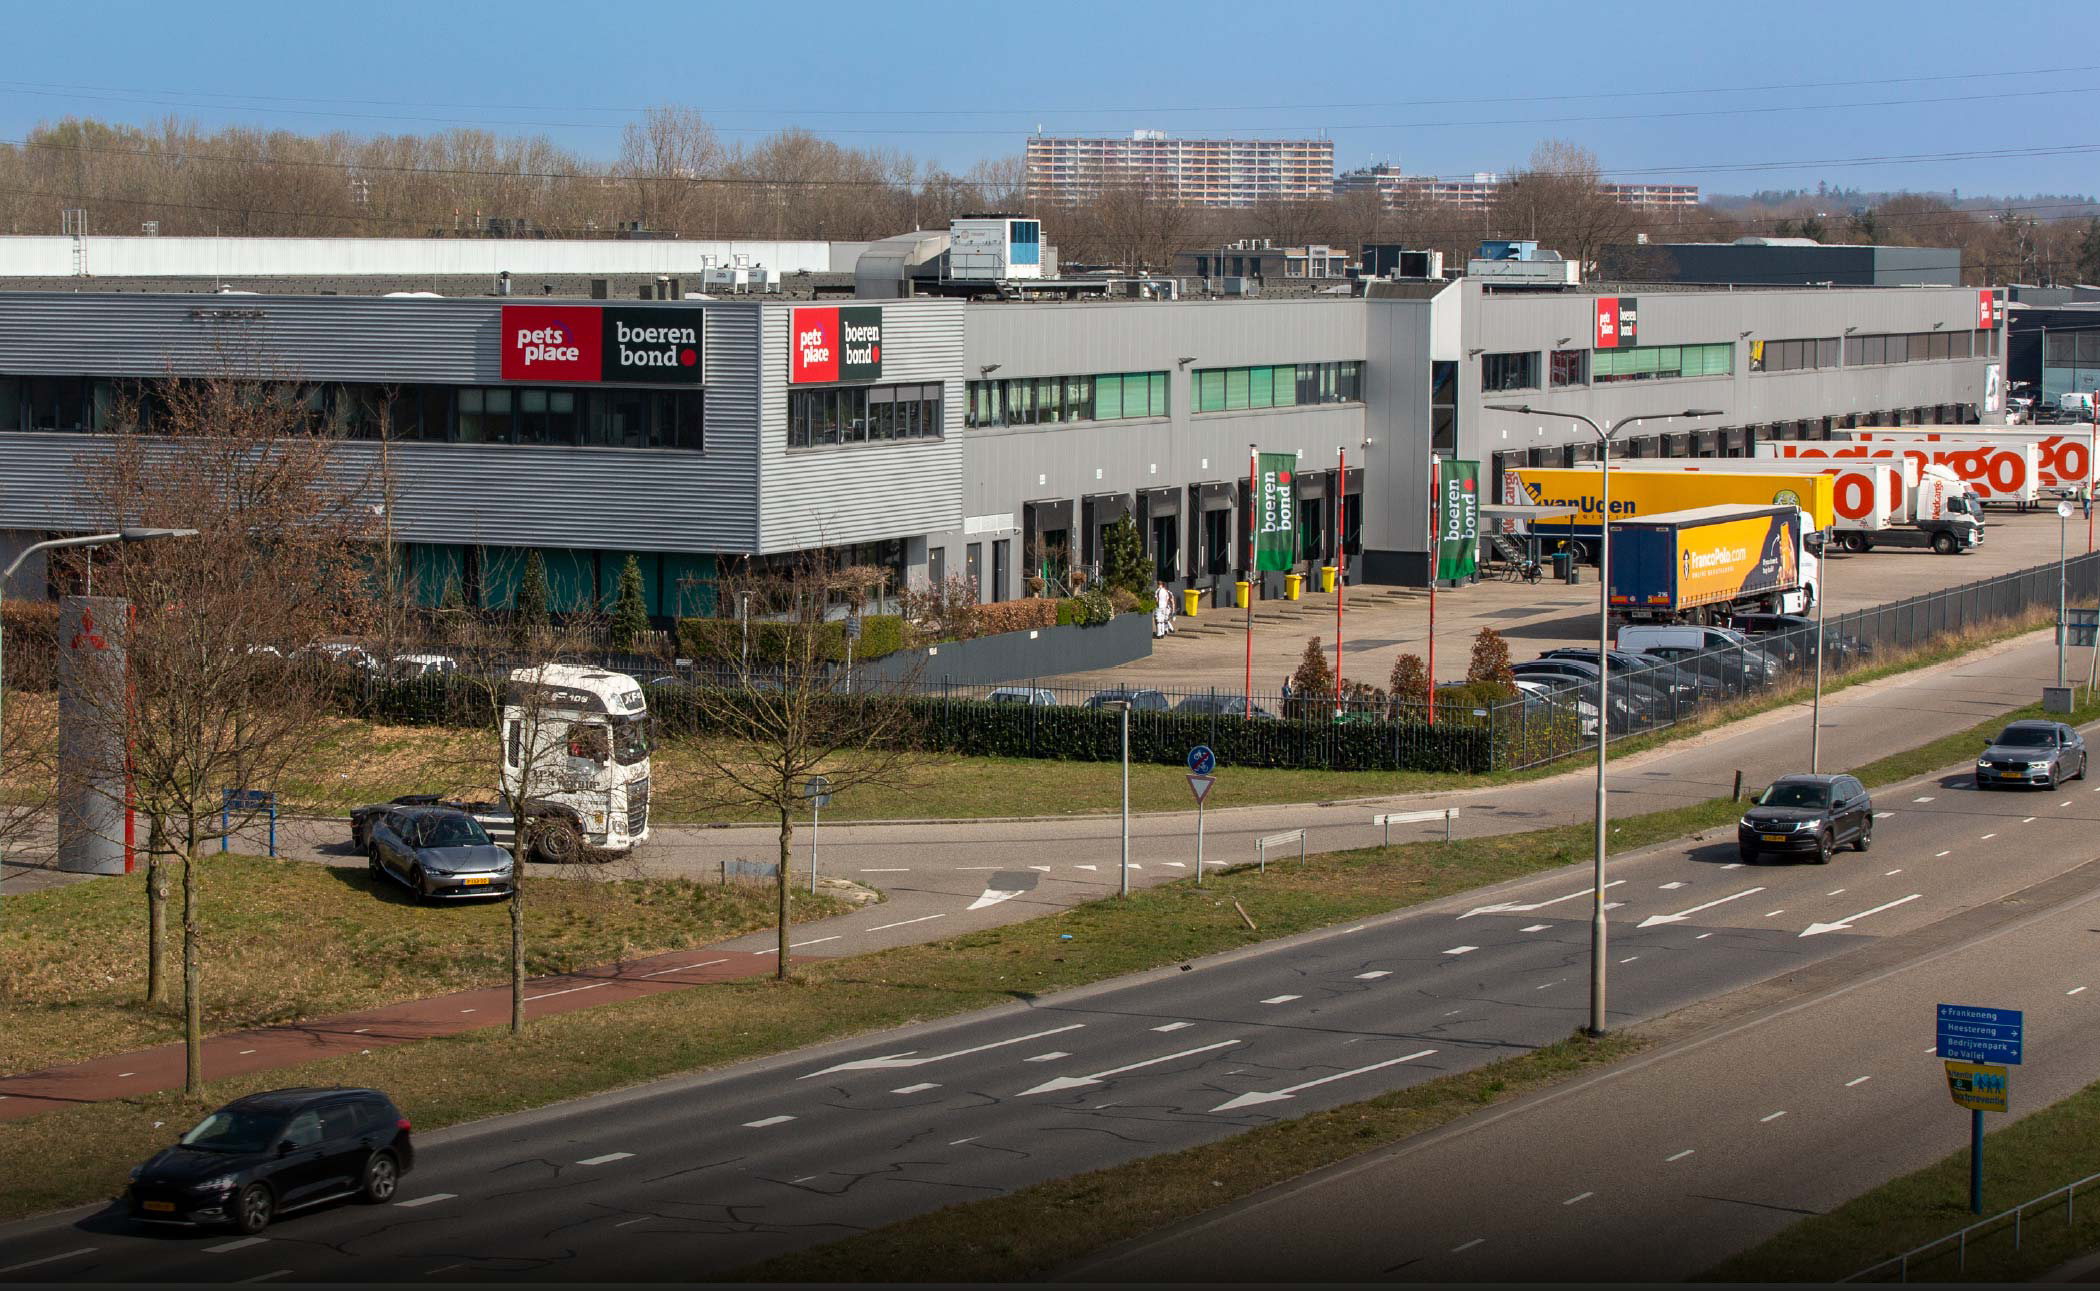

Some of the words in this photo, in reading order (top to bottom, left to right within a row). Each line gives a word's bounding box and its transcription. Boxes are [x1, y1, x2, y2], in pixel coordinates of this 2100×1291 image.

[517, 326, 563, 349] pets
[616, 321, 696, 344] boeren
[799, 328, 823, 350] pets
[844, 321, 880, 343] boeren
[525, 343, 580, 365] place
[620, 345, 678, 367] bond
[803, 345, 829, 368] place
[845, 345, 872, 365] bond
[1260, 471, 1276, 533] boeren
[1276, 485, 1292, 532] bond
[1443, 478, 1460, 542] boeren
[1932, 479, 1945, 520] Nedcargo
[1460, 493, 1477, 540] bond
[1948, 1008, 1997, 1021] Frankeneng
[1948, 1023, 1997, 1036] Heestereng
[1948, 1038, 2008, 1050] Bedrijvenpark
[1960, 1050, 1985, 1060] Vallei
